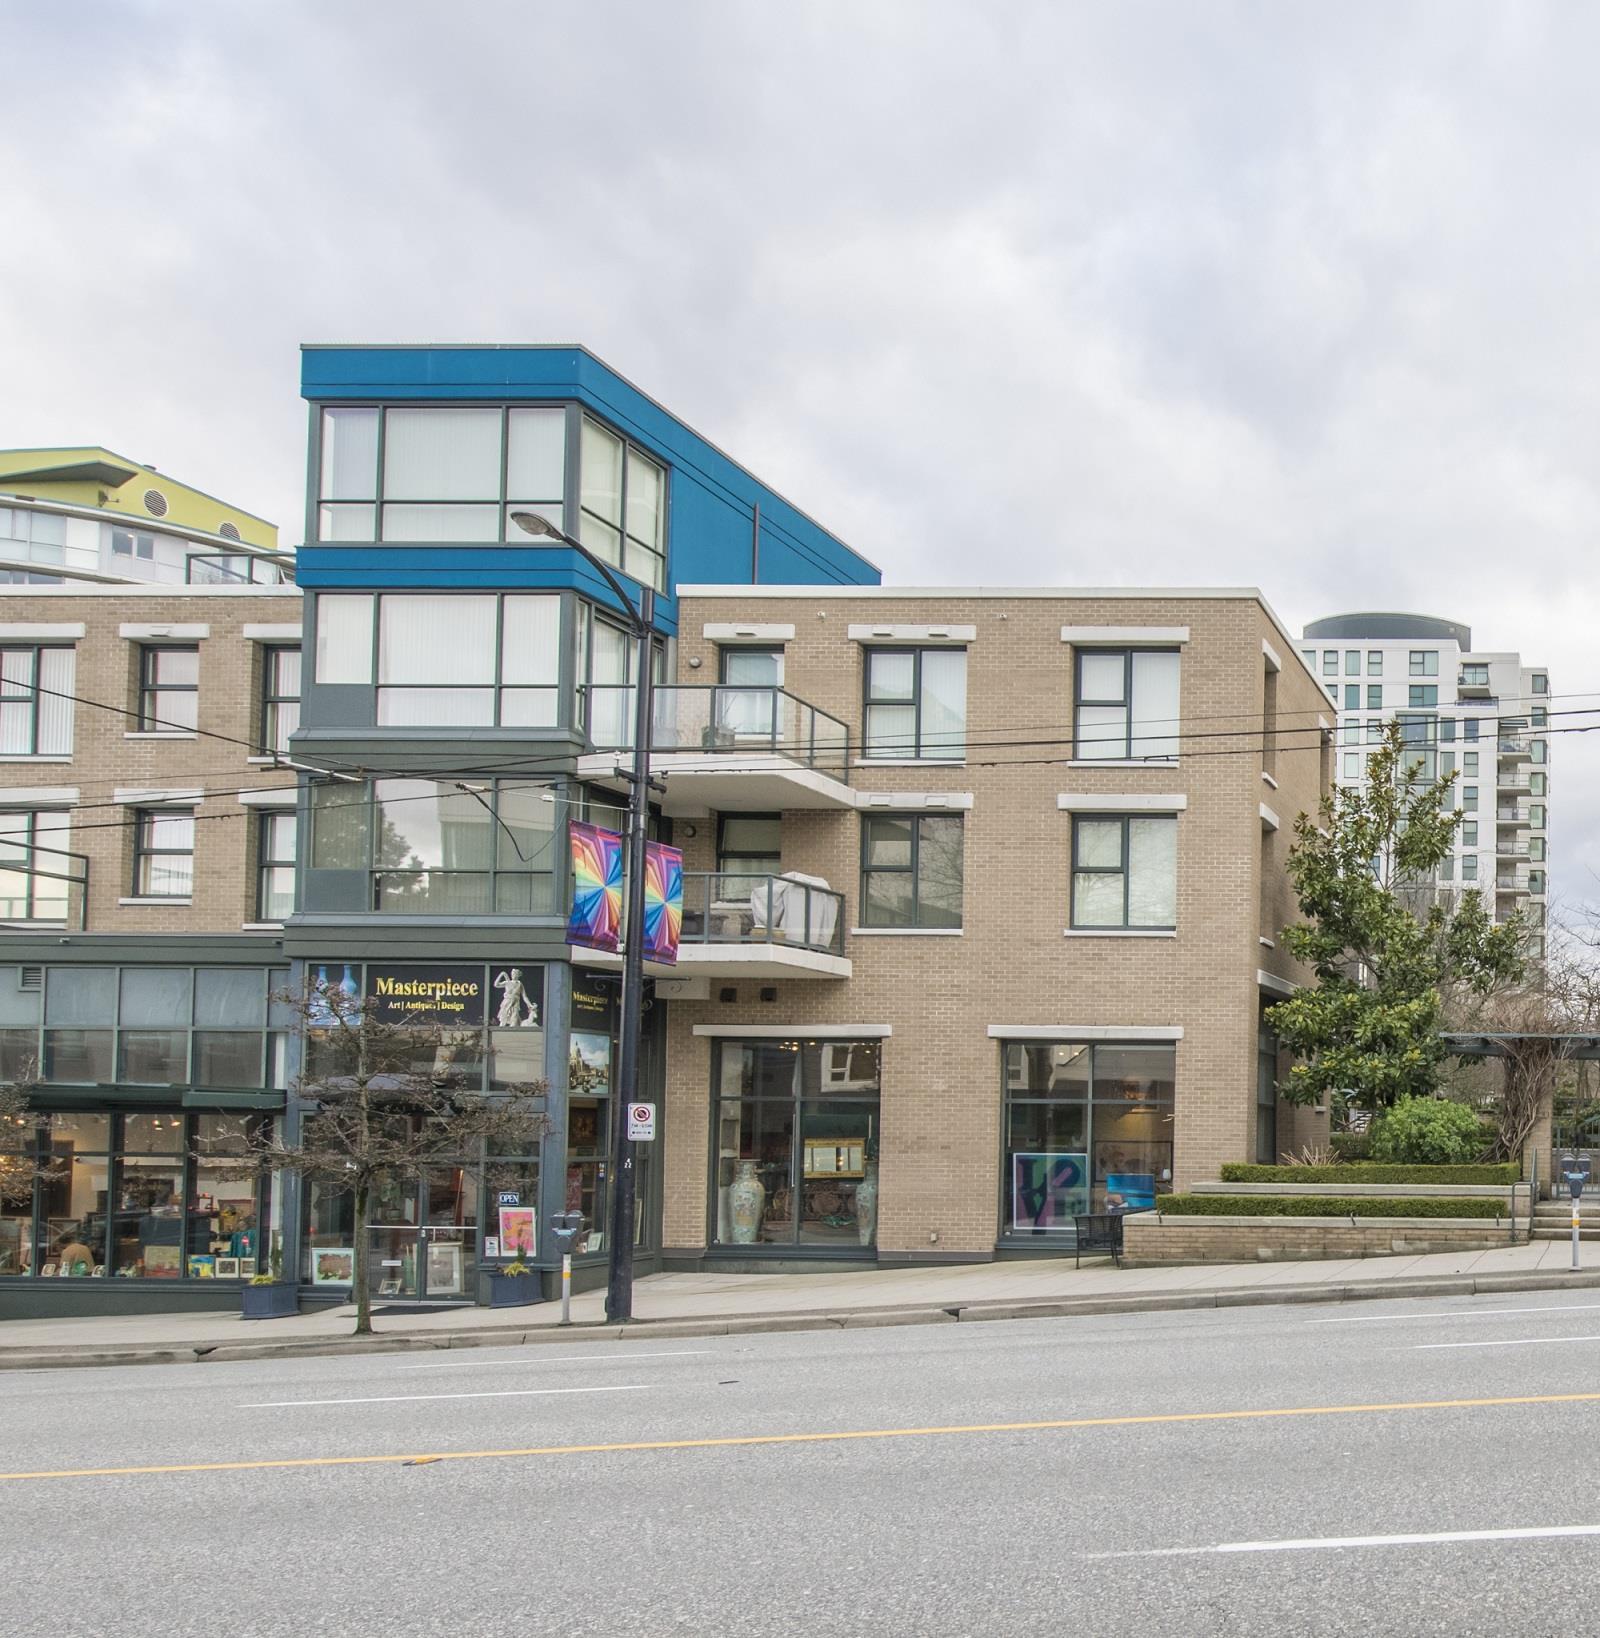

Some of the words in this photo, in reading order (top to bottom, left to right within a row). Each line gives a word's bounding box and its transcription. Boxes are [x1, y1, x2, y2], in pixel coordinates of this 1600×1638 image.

[376, 977, 479, 1001] Masterpiece
[388, 1001, 401, 1009] Art
[441, 1001, 464, 1011] Design
[500, 1194, 519, 1203] OPEN
